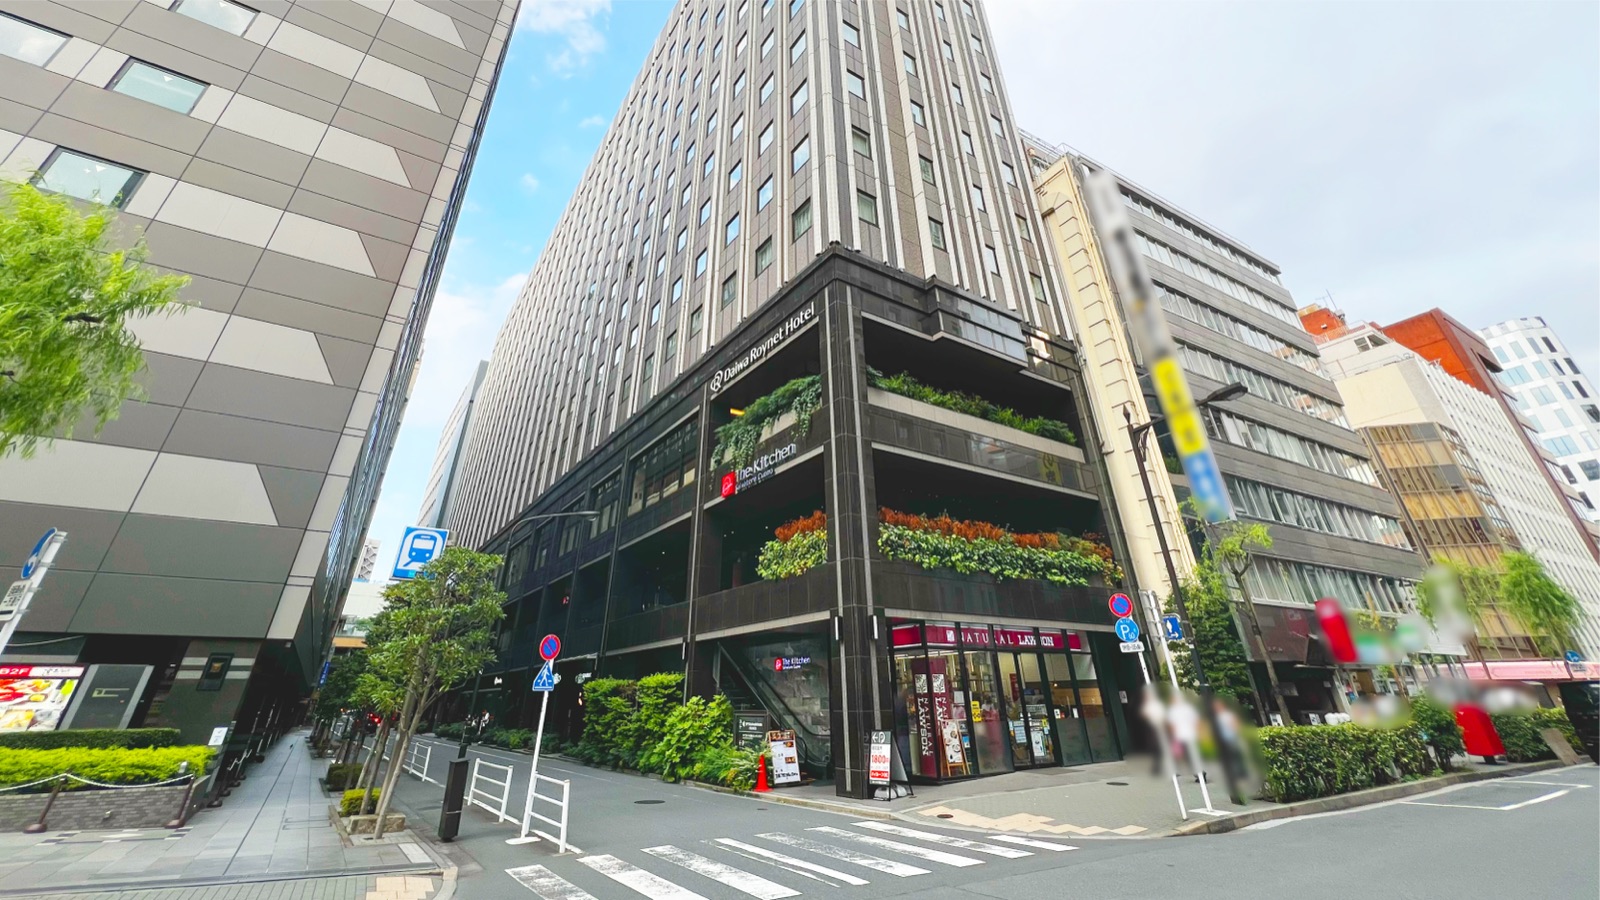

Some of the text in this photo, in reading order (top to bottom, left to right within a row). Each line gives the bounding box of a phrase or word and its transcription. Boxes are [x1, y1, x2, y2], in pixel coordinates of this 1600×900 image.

[723, 301, 815, 382] Daiwa Roynet Hotel
[734, 443, 797, 483] The Kitchen
[1017, 635, 1055, 647] LAWON
[917, 697, 930, 756] LAWSON
[923, 697, 934, 755] NATURAL
